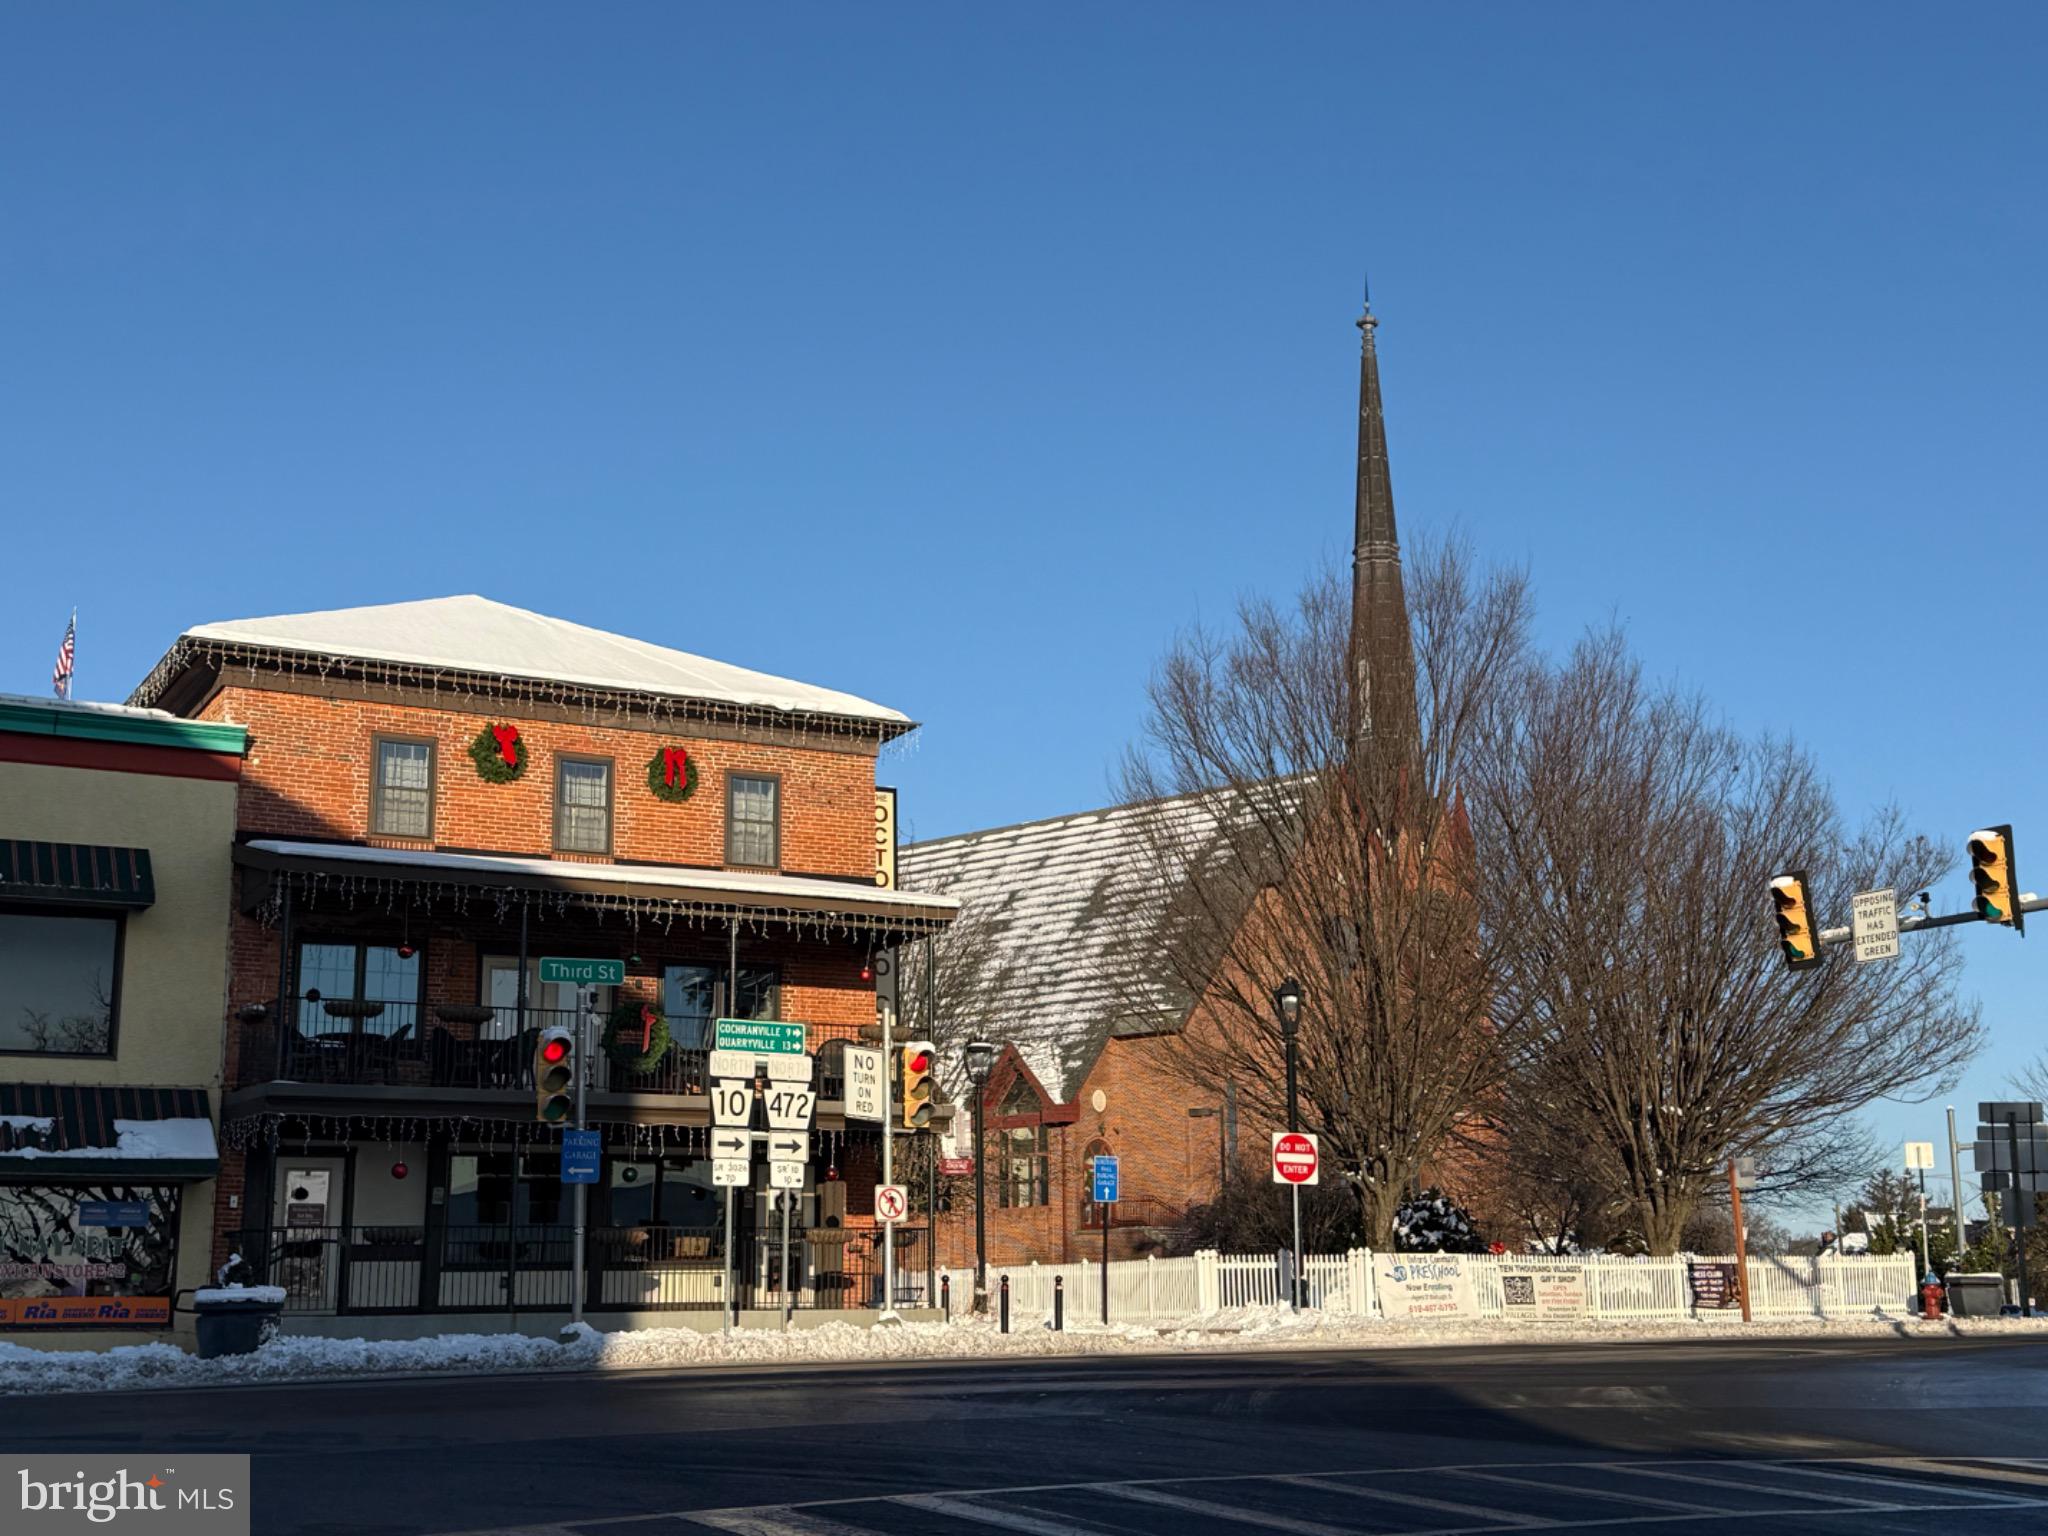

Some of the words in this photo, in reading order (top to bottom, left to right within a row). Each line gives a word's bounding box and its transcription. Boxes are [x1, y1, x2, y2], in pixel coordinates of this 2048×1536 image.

[1854, 893, 1894, 908] OPPOSING
[1858, 906, 1891, 920] TRAFFIC
[1867, 920, 1884, 930] HAS
[1857, 931, 1896, 946] EXTENDED
[1864, 944, 1891, 957] GREEN
[549, 963, 593, 979] Third
[598, 964, 615, 980] St
[719, 1024, 781, 1037] COCHRANVILLE
[786, 1028, 791, 1037] 9
[719, 1037, 775, 1050] QUARRYVILLE
[782, 1041, 791, 1051] 13
[713, 1056, 753, 1076] NORTH
[771, 1059, 809, 1078] NORTH
[854, 1055, 874, 1070] NO
[853, 1072, 875, 1085] TURN
[858, 1087, 871, 1098] ON
[719, 1090, 745, 1116] 10
[769, 1092, 808, 1119] 472
[856, 1101, 873, 1113] RED
[1279, 1142, 1292, 1152] DO
[1295, 1143, 1310, 1152] NOT
[1283, 1164, 1308, 1175] ENTER
[1409, 1264, 1462, 1280] PRESCHOOL
[1515, 1265, 1552, 1273] THOUSAND
[1552, 1265, 1582, 1273] VILLAGES
[1406, 1283, 1422, 1291] Now
[24, 1302, 57, 1318] Ria
[98, 1301, 130, 1318] Ria
